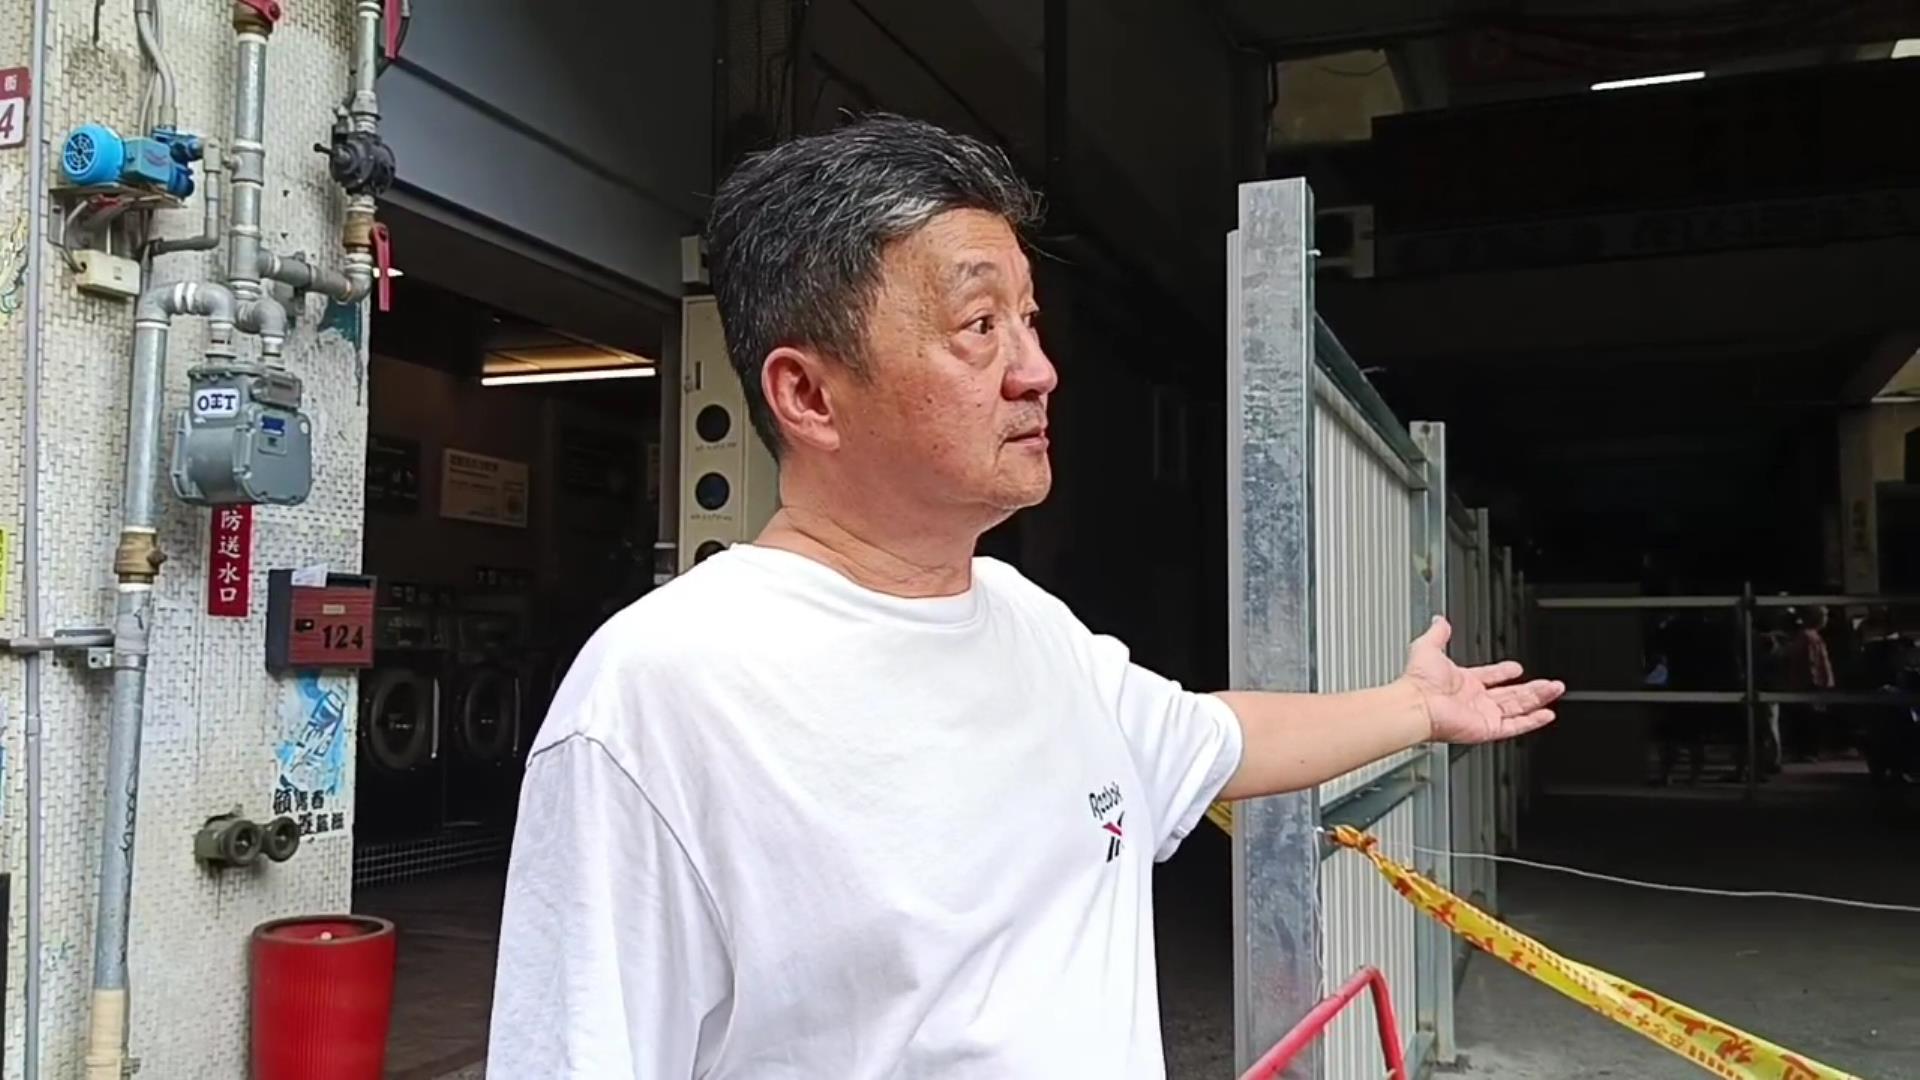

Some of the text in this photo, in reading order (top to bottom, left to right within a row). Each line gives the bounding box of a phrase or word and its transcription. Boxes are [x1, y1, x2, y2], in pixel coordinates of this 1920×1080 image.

[0, 103, 15, 139] 4
[217, 502, 244, 603] 防送水口
[322, 624, 364, 650] 124
